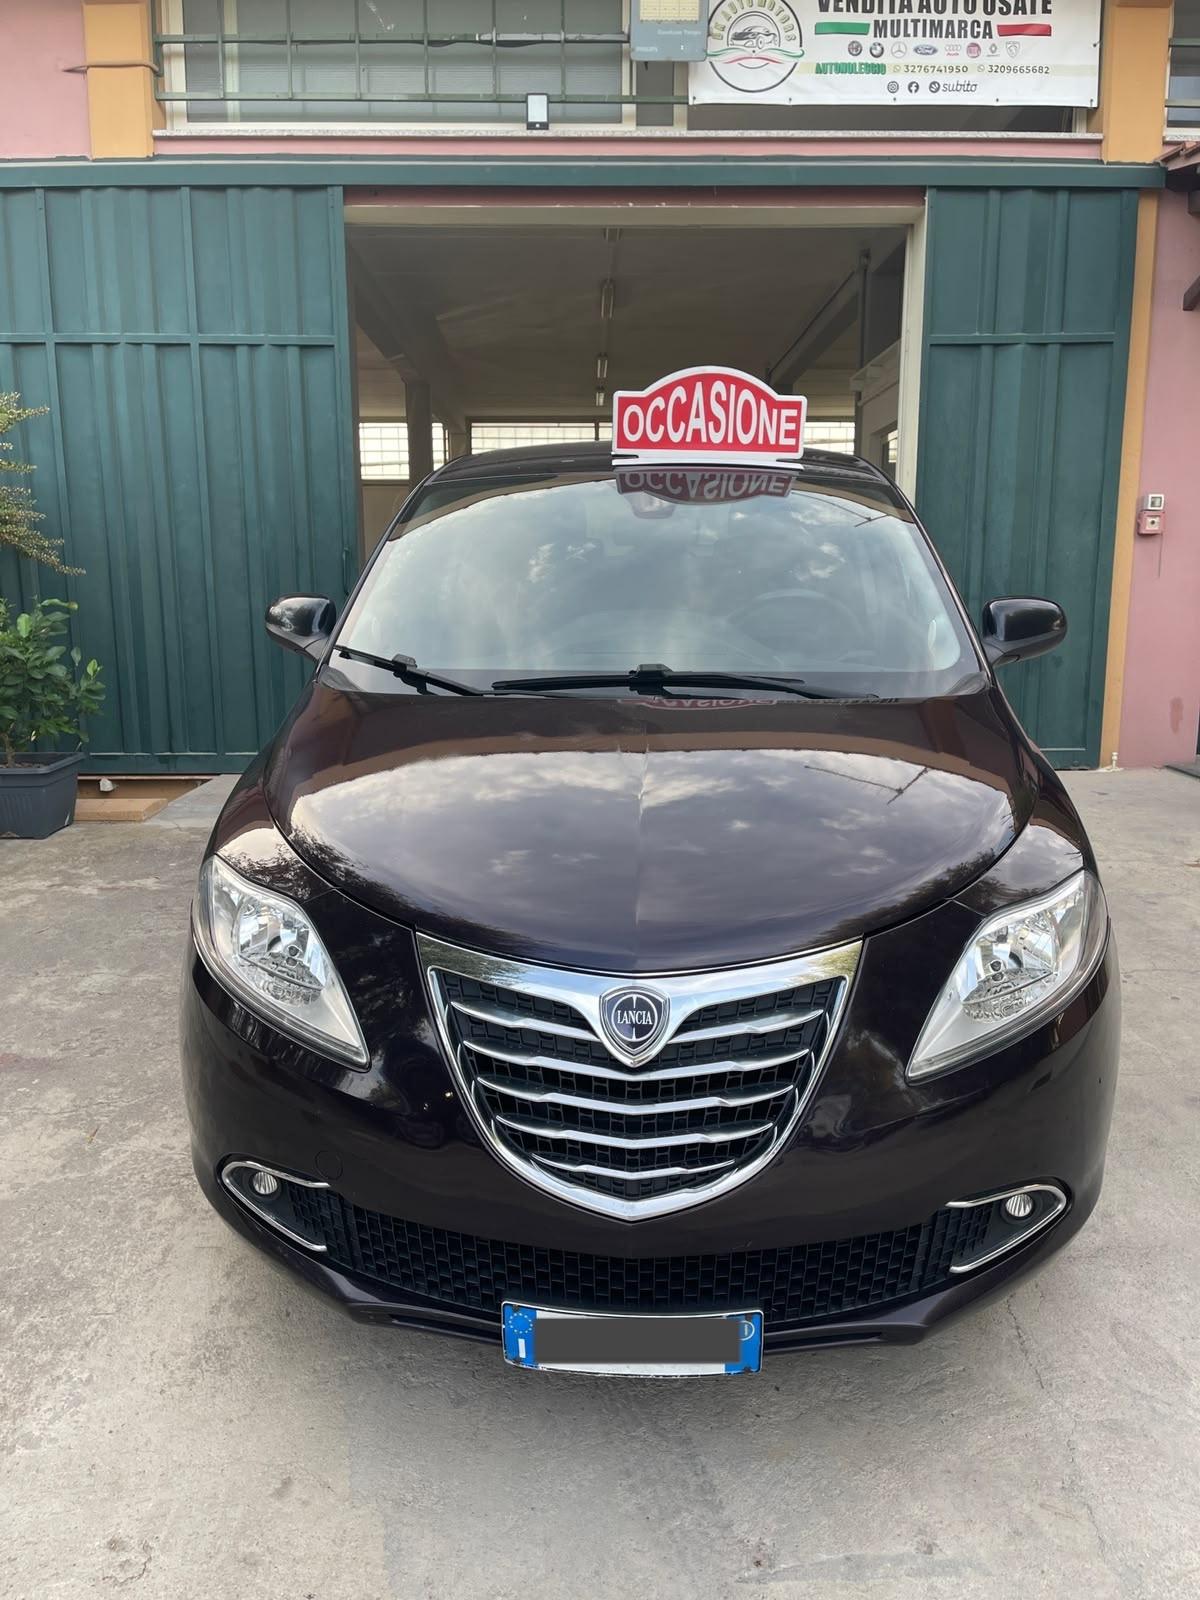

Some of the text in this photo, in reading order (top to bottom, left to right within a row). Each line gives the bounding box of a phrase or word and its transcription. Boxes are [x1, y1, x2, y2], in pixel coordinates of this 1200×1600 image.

[818, 0, 1052, 15] VENDITA AUTO USATE
[873, 19, 993, 39] MULTIMARCA
[904, 65, 969, 74] 3276741950
[988, 65, 1050, 74] 3209665682
[942, 80, 978, 93] subito
[622, 380, 798, 446] OCCASIONE
[617, 1010, 653, 1025] LANCIA
